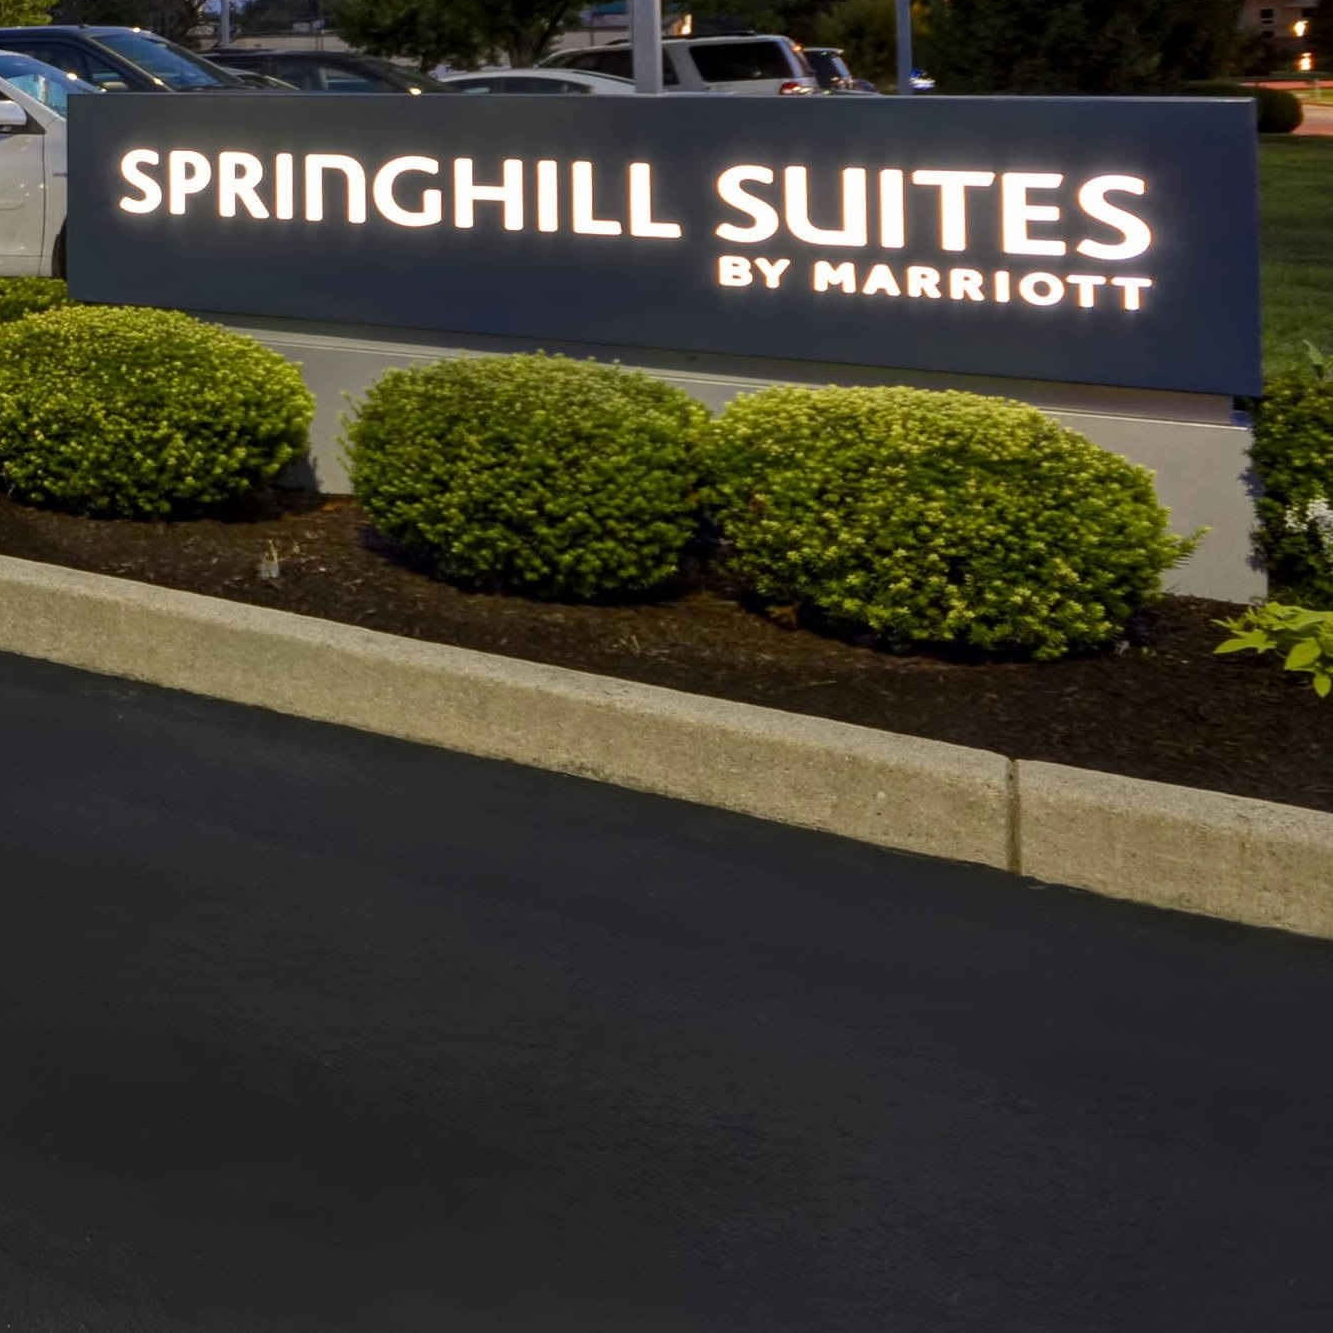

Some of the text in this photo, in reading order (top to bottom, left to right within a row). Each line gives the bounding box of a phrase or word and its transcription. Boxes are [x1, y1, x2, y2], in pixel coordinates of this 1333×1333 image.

[118, 148, 1153, 261] SPRINGHILL SUITES
[718, 255, 1153, 311] BY MARRIOTT
